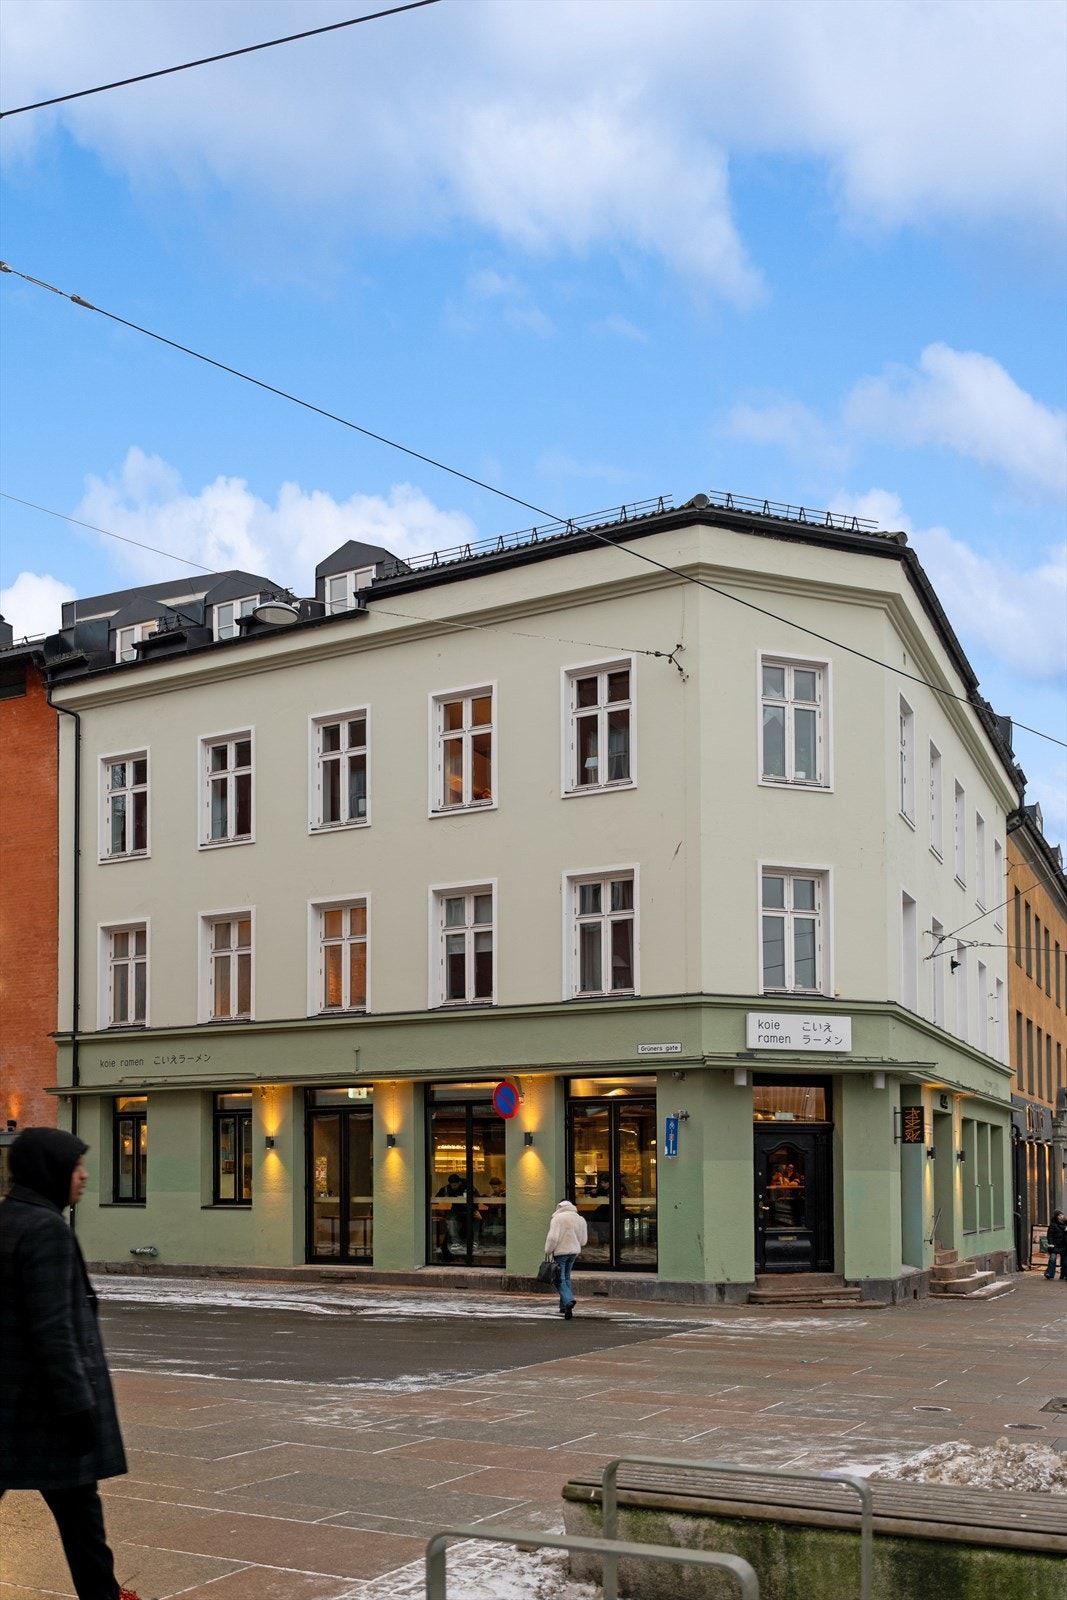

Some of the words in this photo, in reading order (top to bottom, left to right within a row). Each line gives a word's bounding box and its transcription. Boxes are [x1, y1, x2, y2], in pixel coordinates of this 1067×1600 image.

[757, 1019, 780, 1030] koie
[802, 1021, 832, 1033] こいえ
[757, 1034, 791, 1044] ramen
[802, 1034, 843, 1045] ラーメン
[665, 1045, 679, 1053] gate
[99, 1059, 116, 1068] koie
[120, 1058, 144, 1067] ramen
[153, 1053, 211, 1065] こいえラーメン
